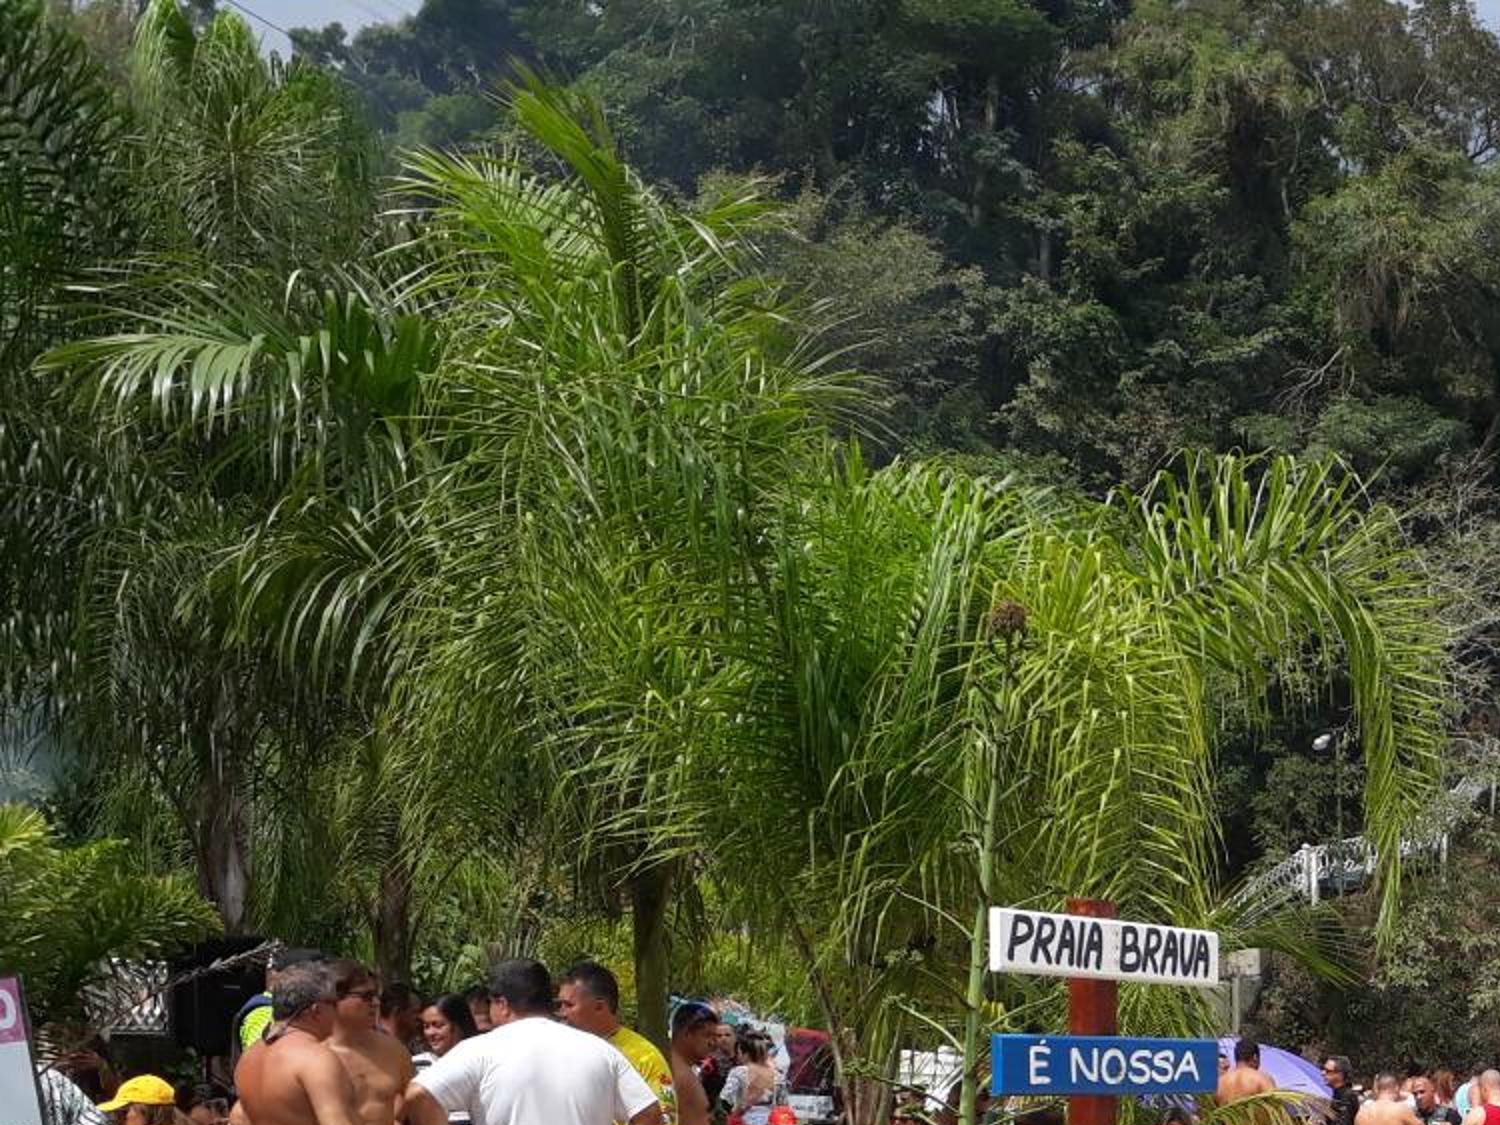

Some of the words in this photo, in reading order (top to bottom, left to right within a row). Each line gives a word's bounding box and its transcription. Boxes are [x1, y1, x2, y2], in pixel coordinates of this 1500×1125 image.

[1007, 913, 1104, 970] PRAIA
[1119, 925, 1210, 978] BRAVA
[1029, 1039, 1051, 1086] É
[1070, 1047, 1199, 1085] NOSSA
